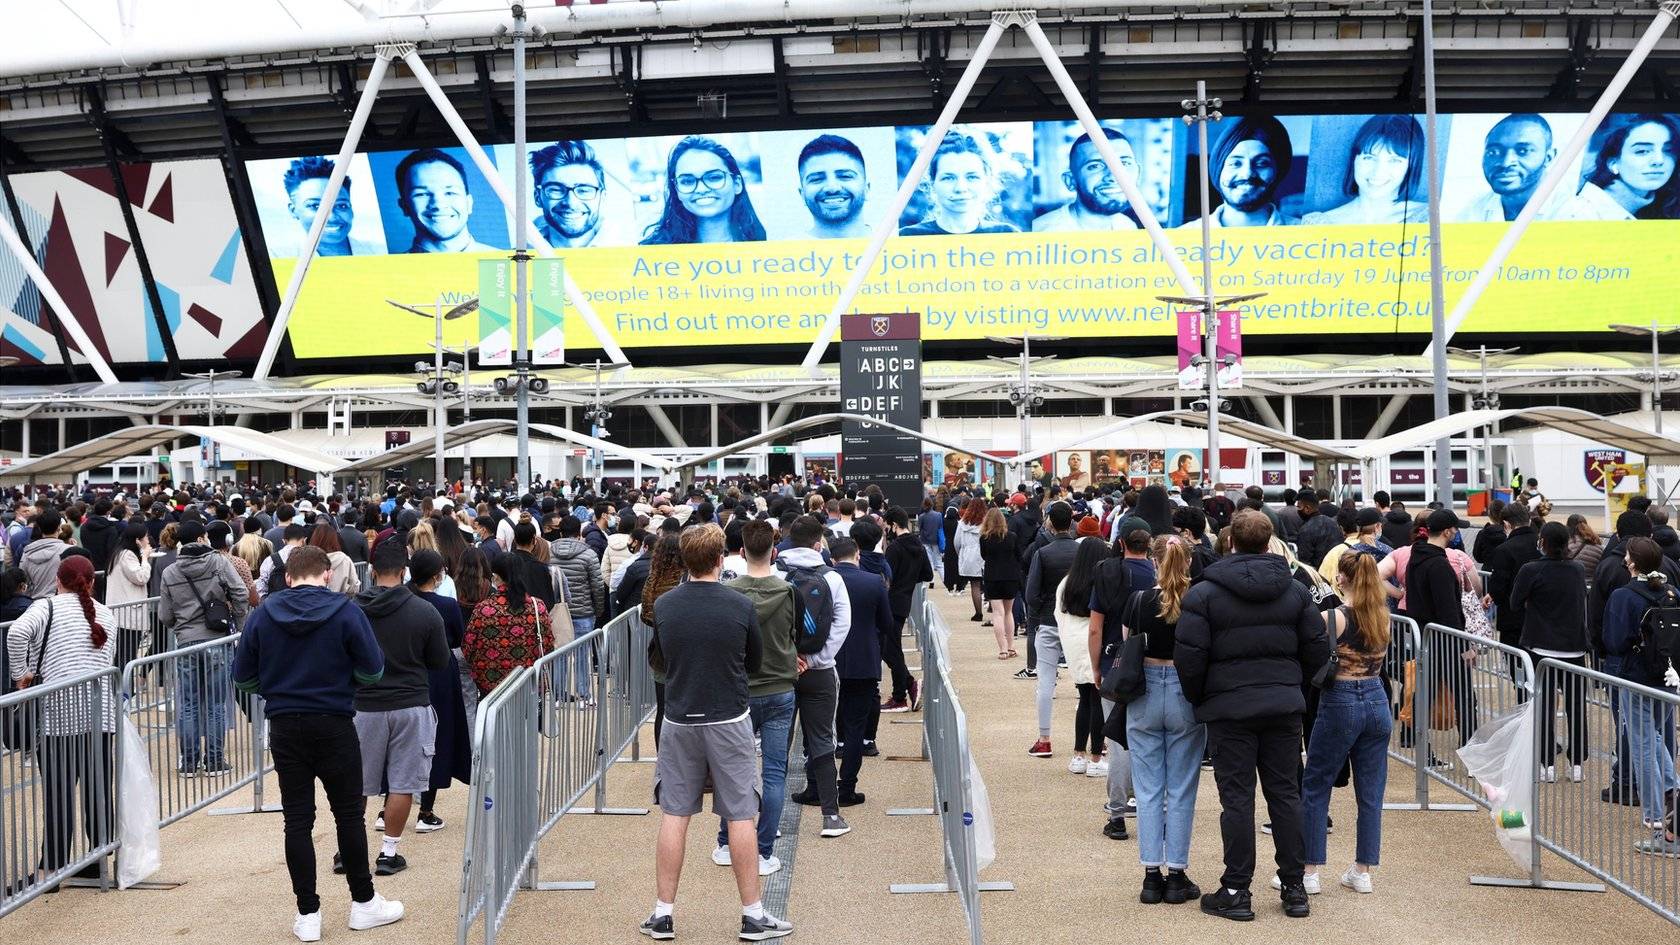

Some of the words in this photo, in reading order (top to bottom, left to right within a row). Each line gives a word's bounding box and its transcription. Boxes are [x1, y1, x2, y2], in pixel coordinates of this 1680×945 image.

[633, 258, 681, 277] Are
[689, 260, 742, 280] you
[752, 250, 832, 278] ready
[880, 249, 936, 275] join
[946, 246, 995, 268] the
[1006, 243, 1122, 266] millions
[1133, 240, 1244, 267] aleady
[1254, 235, 1431, 261] vaccinated?
[657, 286, 692, 299] 18+
[700, 284, 754, 303] living
[761, 285, 778, 296] in
[786, 281, 842, 297] north
[856, 280, 890, 294] ast
[898, 278, 975, 294] London
[984, 279, 1004, 291] to
[1010, 280, 1020, 291] a
[1028, 273, 1146, 290] vaccination
[1219, 274, 1245, 287] on
[1253, 269, 1345, 288] Saturday
[1354, 267, 1376, 284] 19
[1381, 266, 1432, 284] June
[1497, 265, 1551, 281] 10am
[1558, 266, 1578, 281] to
[1584, 265, 1631, 284] 8pm
[616, 312, 669, 331] Find
[675, 314, 719, 331] out
[726, 314, 791, 330] more
[799, 314, 828, 329] an
[926, 306, 957, 330] by
[964, 303, 1049, 330] visting
